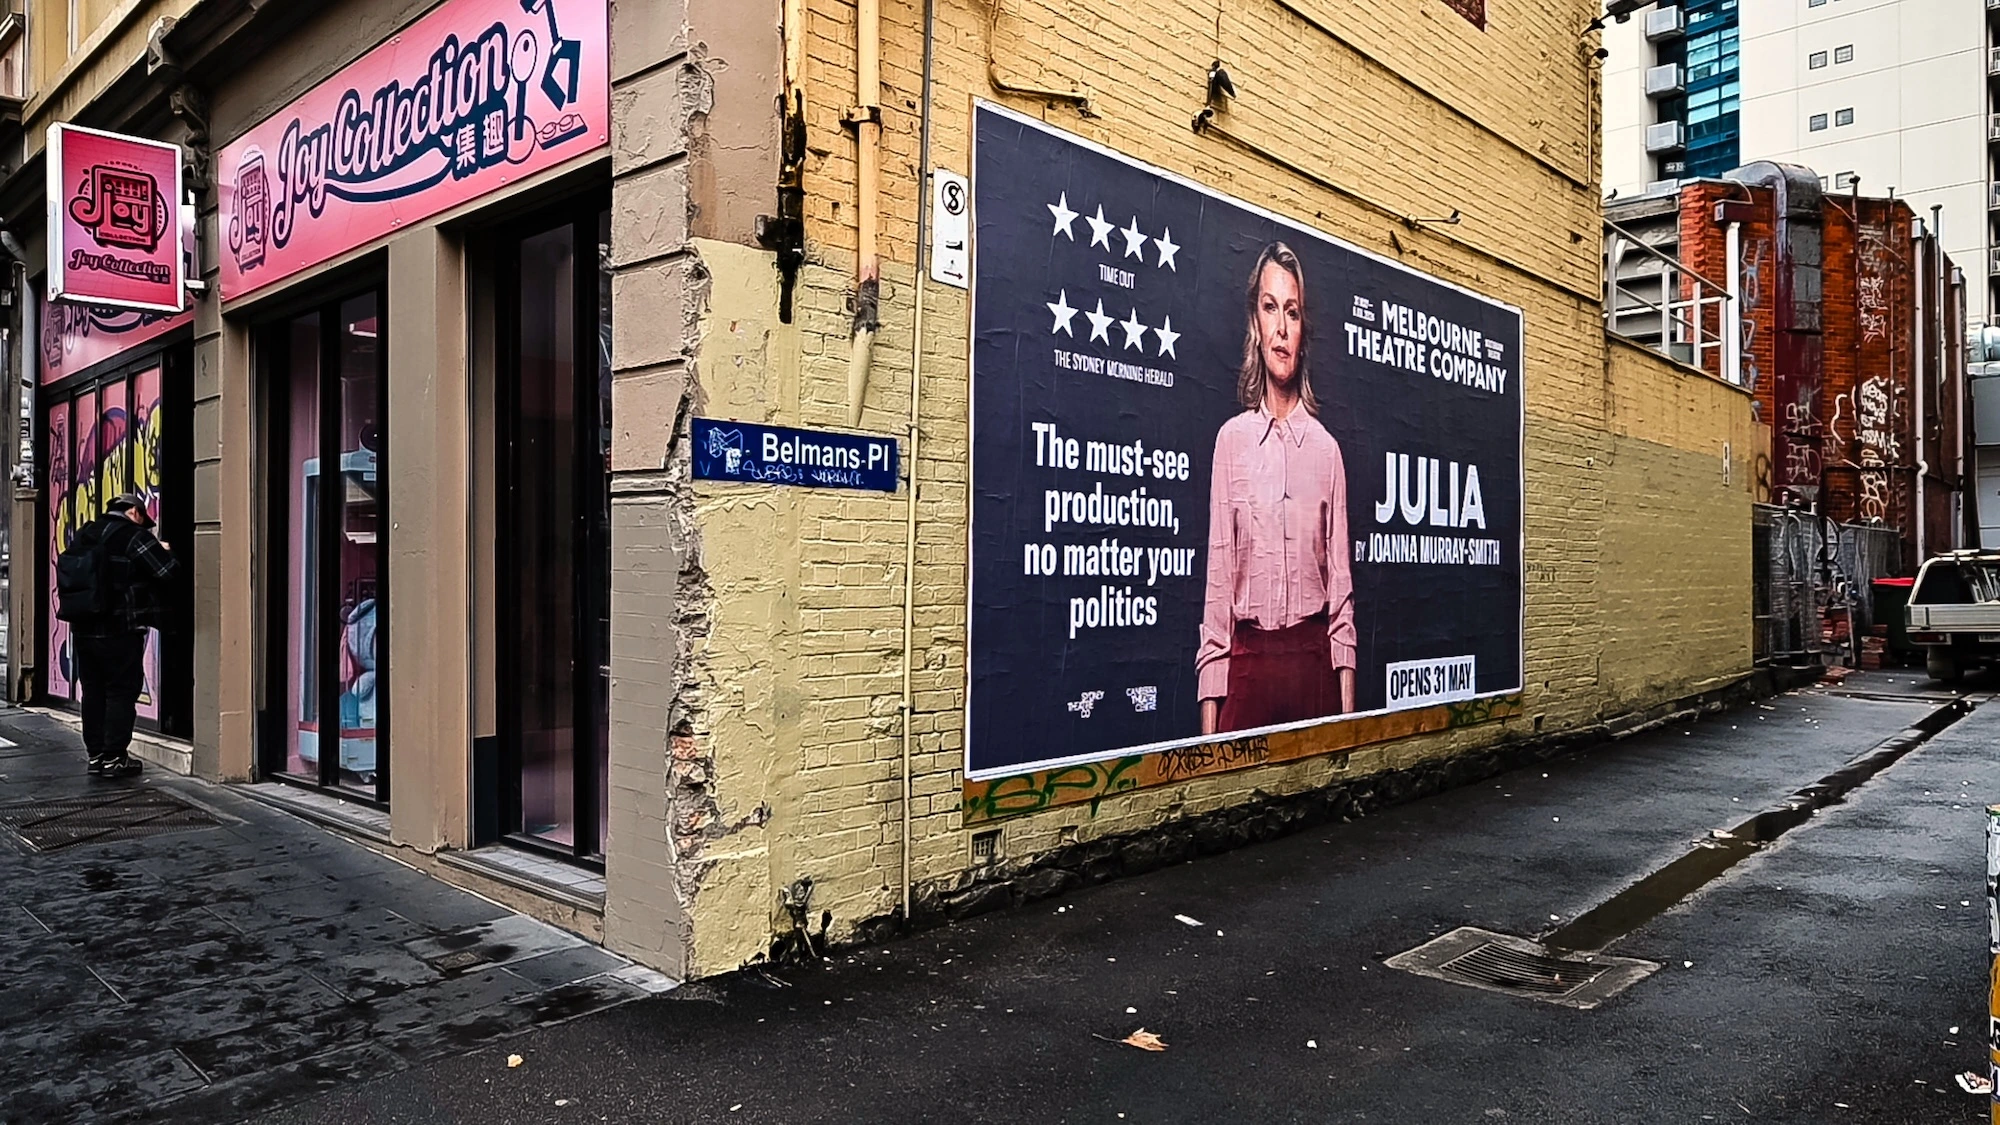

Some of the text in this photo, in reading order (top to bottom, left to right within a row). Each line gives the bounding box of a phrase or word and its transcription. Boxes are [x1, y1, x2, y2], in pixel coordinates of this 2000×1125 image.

[272, 23, 509, 248] Joy Collection
[68, 249, 169, 276] Joy Collection
[1099, 264, 1136, 289] TIME OUT
[1381, 300, 1482, 359] MELBOURNE
[1054, 349, 1174, 388] THE SYDNEY MORNING HERALD
[1344, 321, 1507, 394] THEATRE COMPANY
[762, 432, 861, 470] Belmans
[1032, 422, 1190, 481] The must-see
[1045, 482, 1180, 535] production,
[1375, 451, 1486, 530] JULIA
[1024, 538, 1196, 586] no matter your
[1355, 533, 1500, 565] BY JOANNA MURRAY-SMITH
[1069, 585, 1157, 639] politics
[1390, 662, 1472, 700] OPENS 31 MAY
